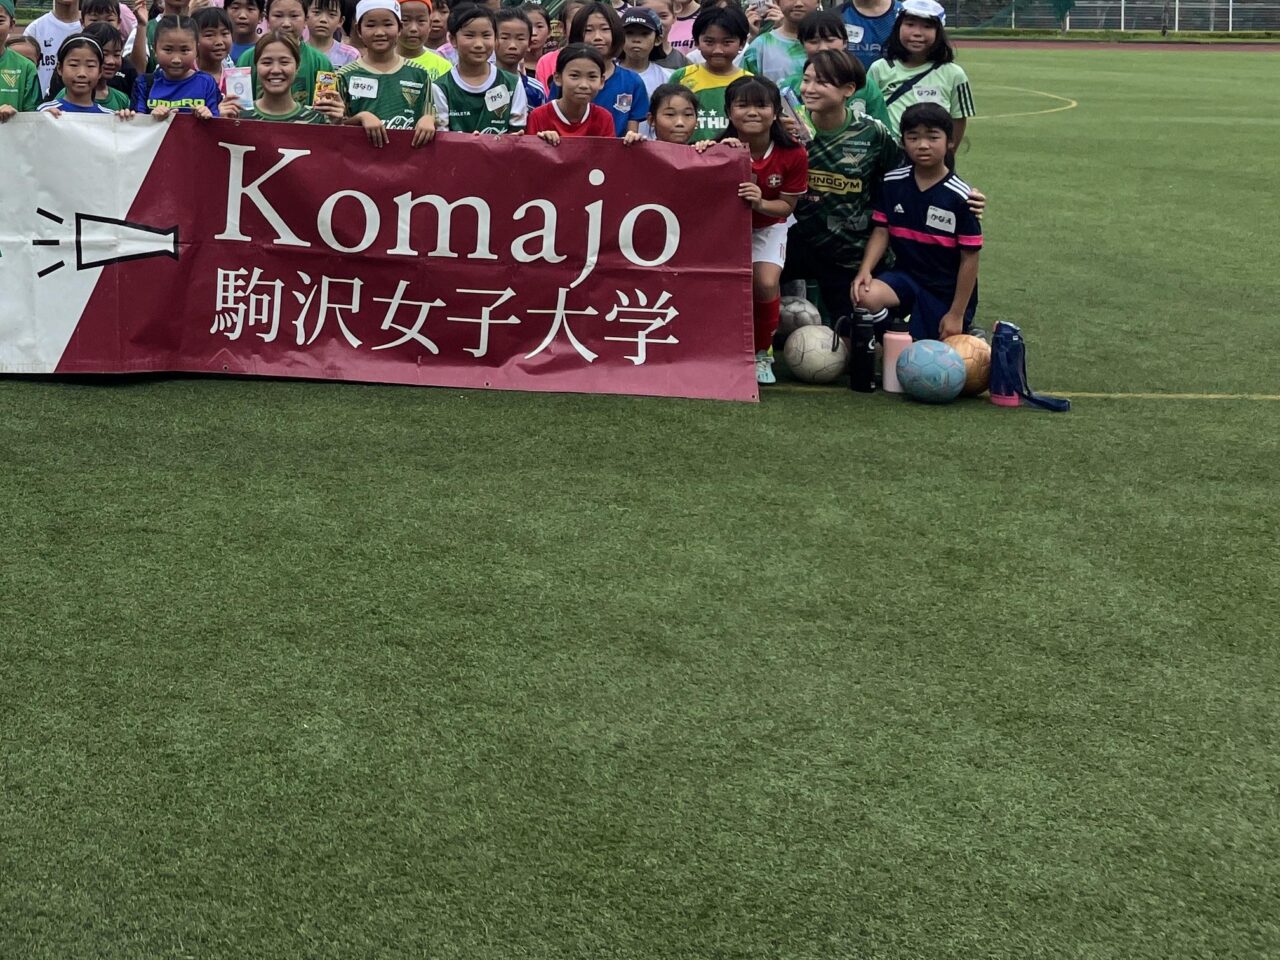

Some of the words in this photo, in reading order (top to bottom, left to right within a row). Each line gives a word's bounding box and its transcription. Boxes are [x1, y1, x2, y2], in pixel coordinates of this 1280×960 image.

[214, 141, 681, 288] Komajo
[807, 174, 861, 189] HNOGYM
[210, 266, 680, 366] 駒沢女子大学
